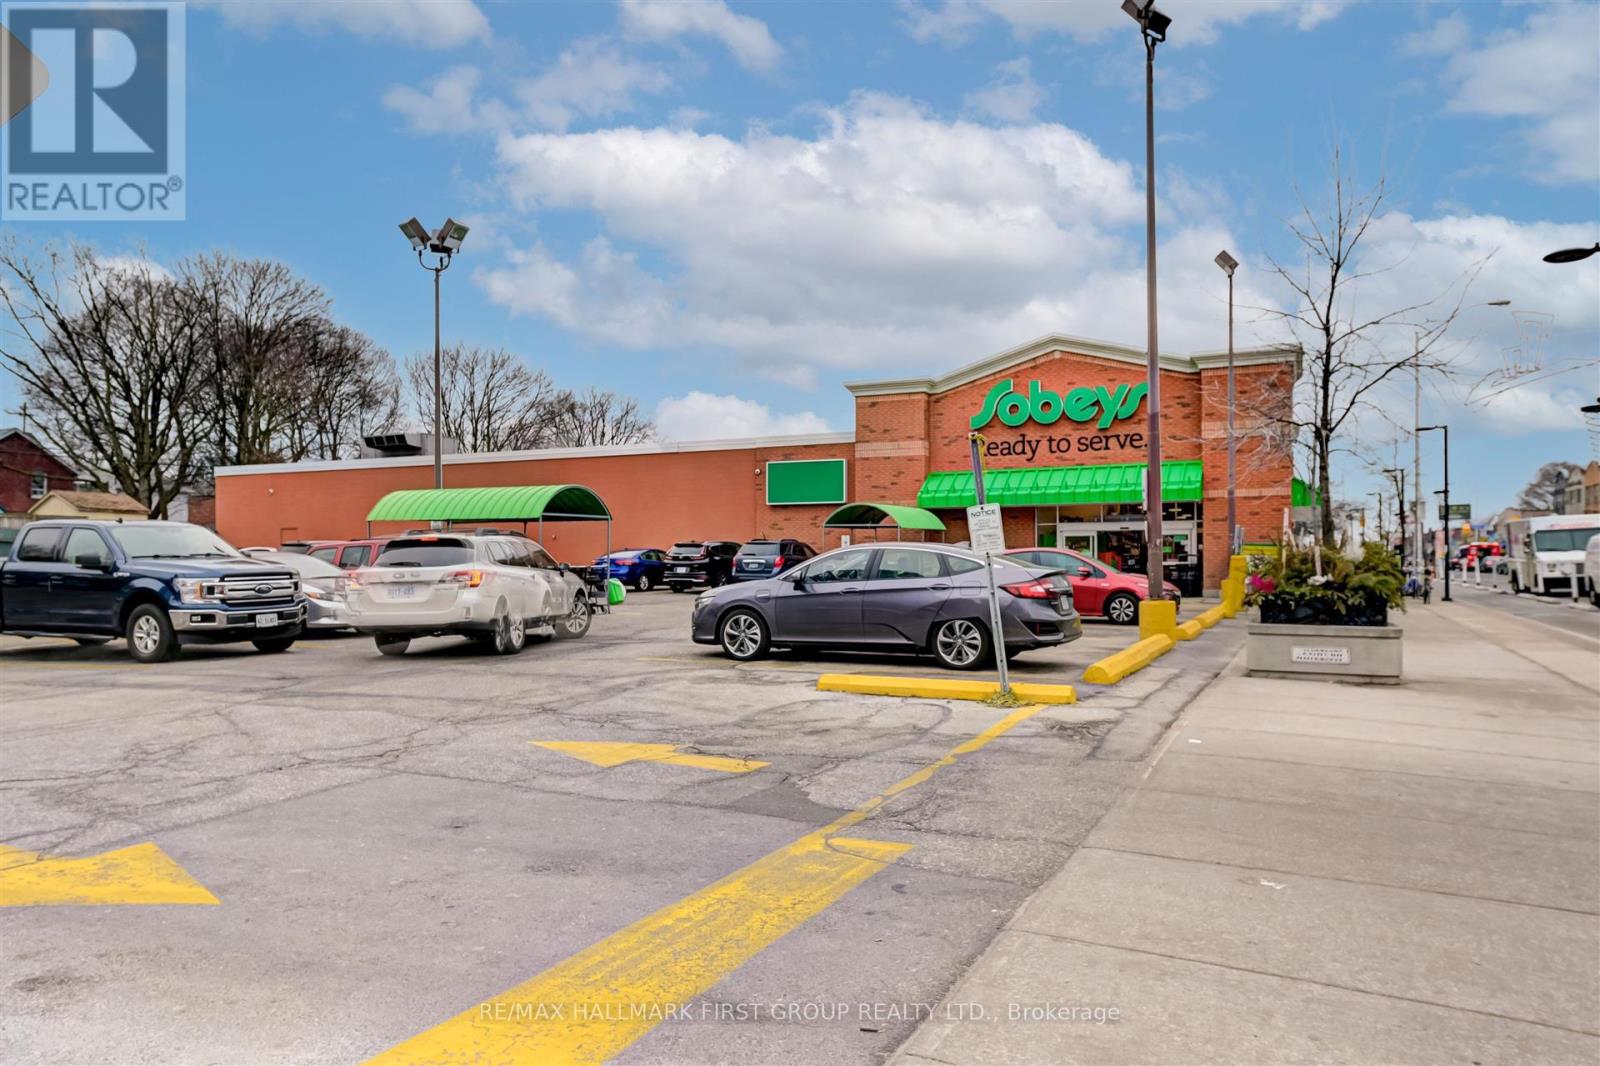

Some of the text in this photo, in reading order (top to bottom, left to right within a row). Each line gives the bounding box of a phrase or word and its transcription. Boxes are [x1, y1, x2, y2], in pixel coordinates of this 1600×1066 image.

[970, 378, 1150, 430] Sobeys
[1048, 436, 1072, 454] to
[1077, 432, 1148, 453] serve.
[970, 509, 996, 518] NOTICE
